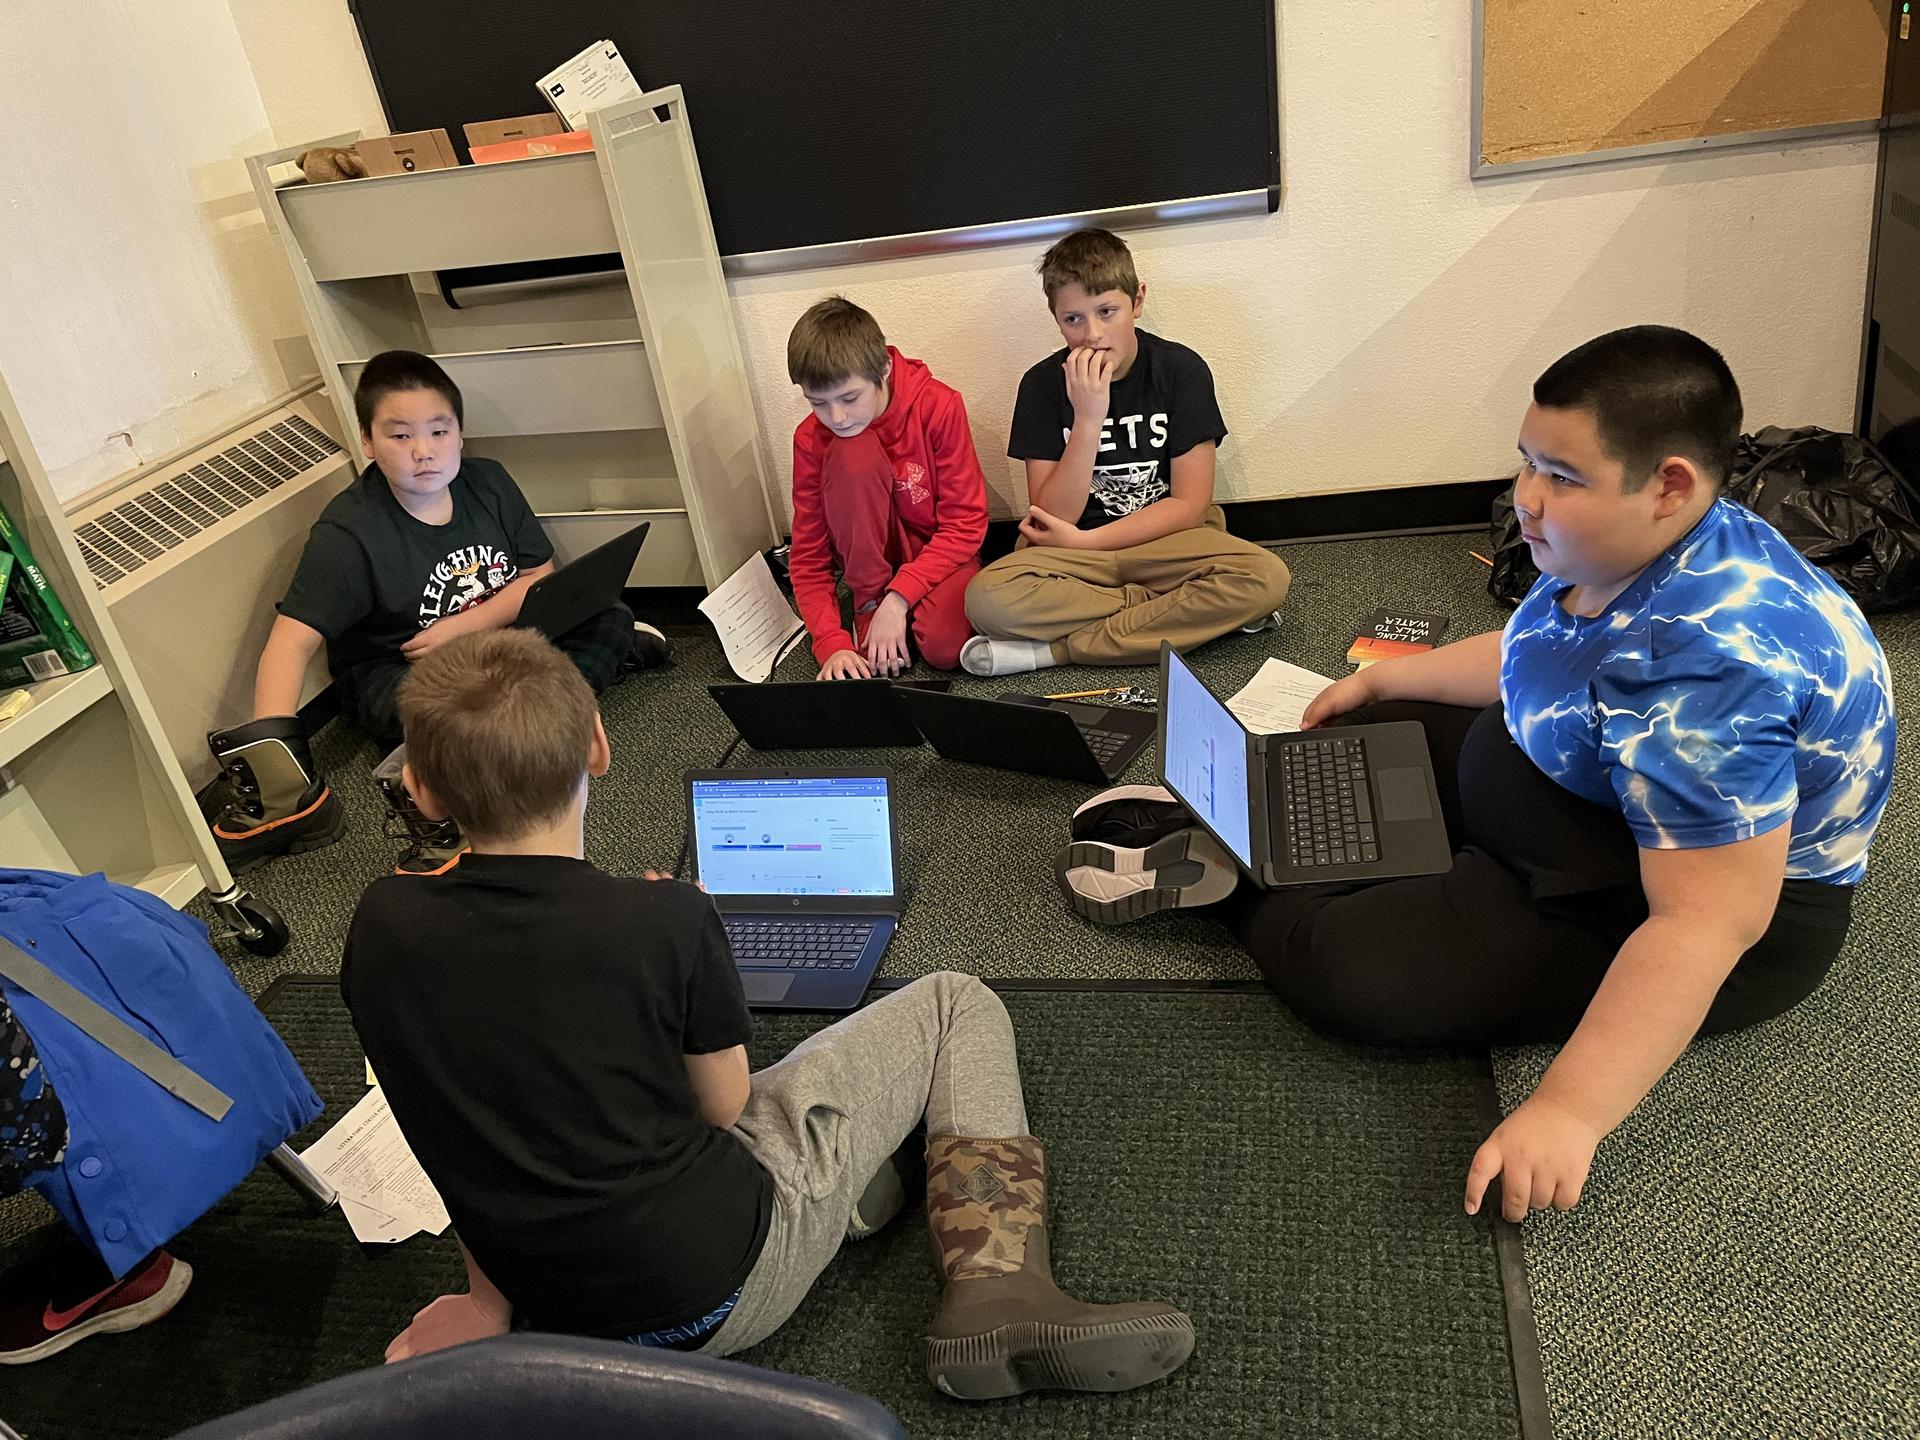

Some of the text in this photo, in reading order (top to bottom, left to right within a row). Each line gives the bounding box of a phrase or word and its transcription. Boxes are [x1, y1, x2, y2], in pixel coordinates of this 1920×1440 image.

[1063, 413, 1168, 452] ETS
[27, 565, 46, 590] MATH
[1385, 617, 1429, 629] WATER
[1376, 632, 1408, 641] LONG
[1396, 626, 1429, 636] WALK
